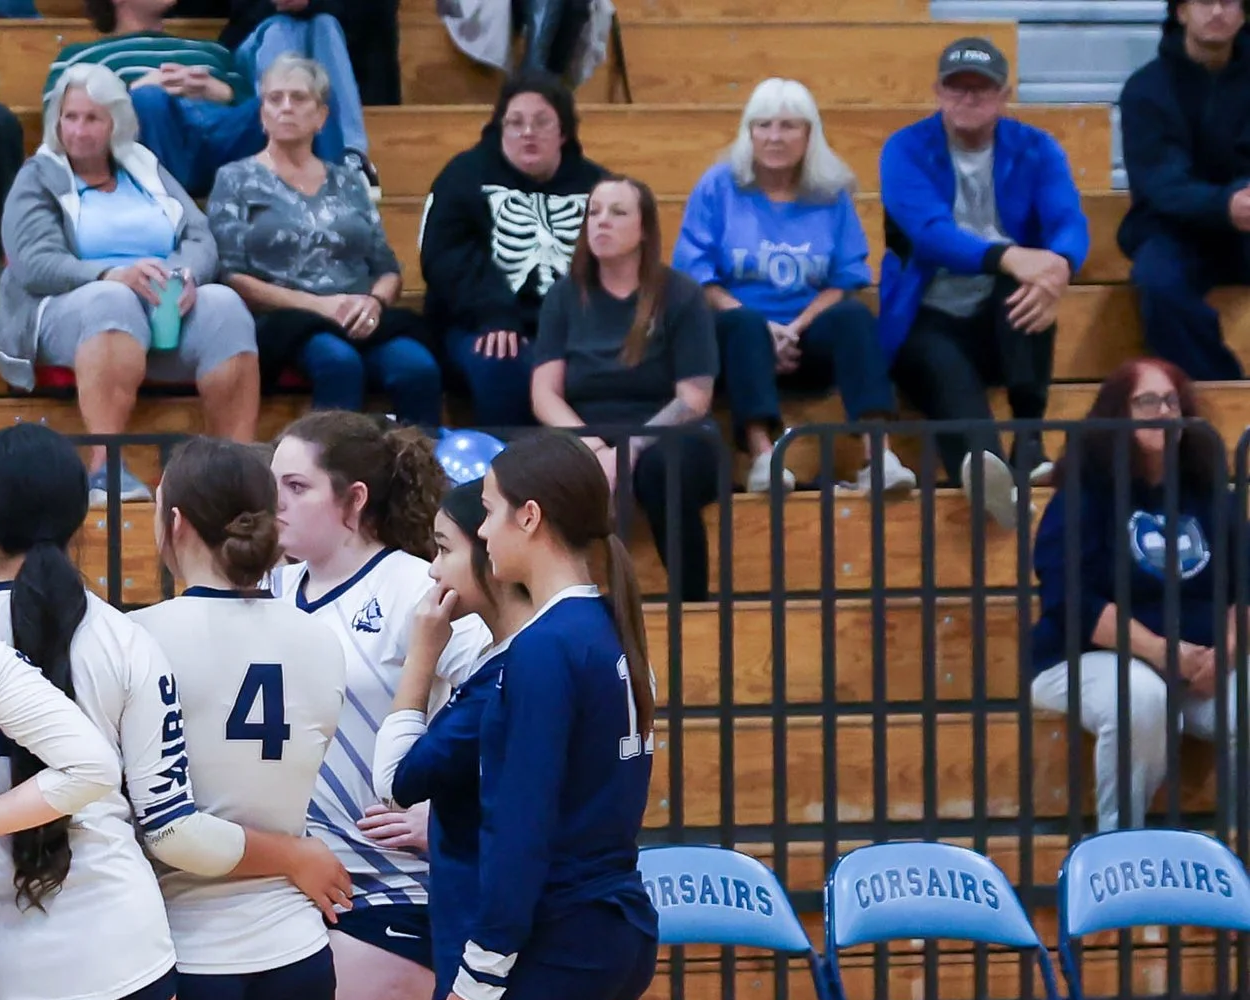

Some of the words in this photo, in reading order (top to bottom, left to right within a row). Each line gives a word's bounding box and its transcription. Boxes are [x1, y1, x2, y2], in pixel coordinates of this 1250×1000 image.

[224, 662, 292, 762] 4
[643, 873, 774, 916] ORSAIRS
[855, 866, 1000, 910] CORSAIRS
[1089, 857, 1233, 903] CORSAIRS
